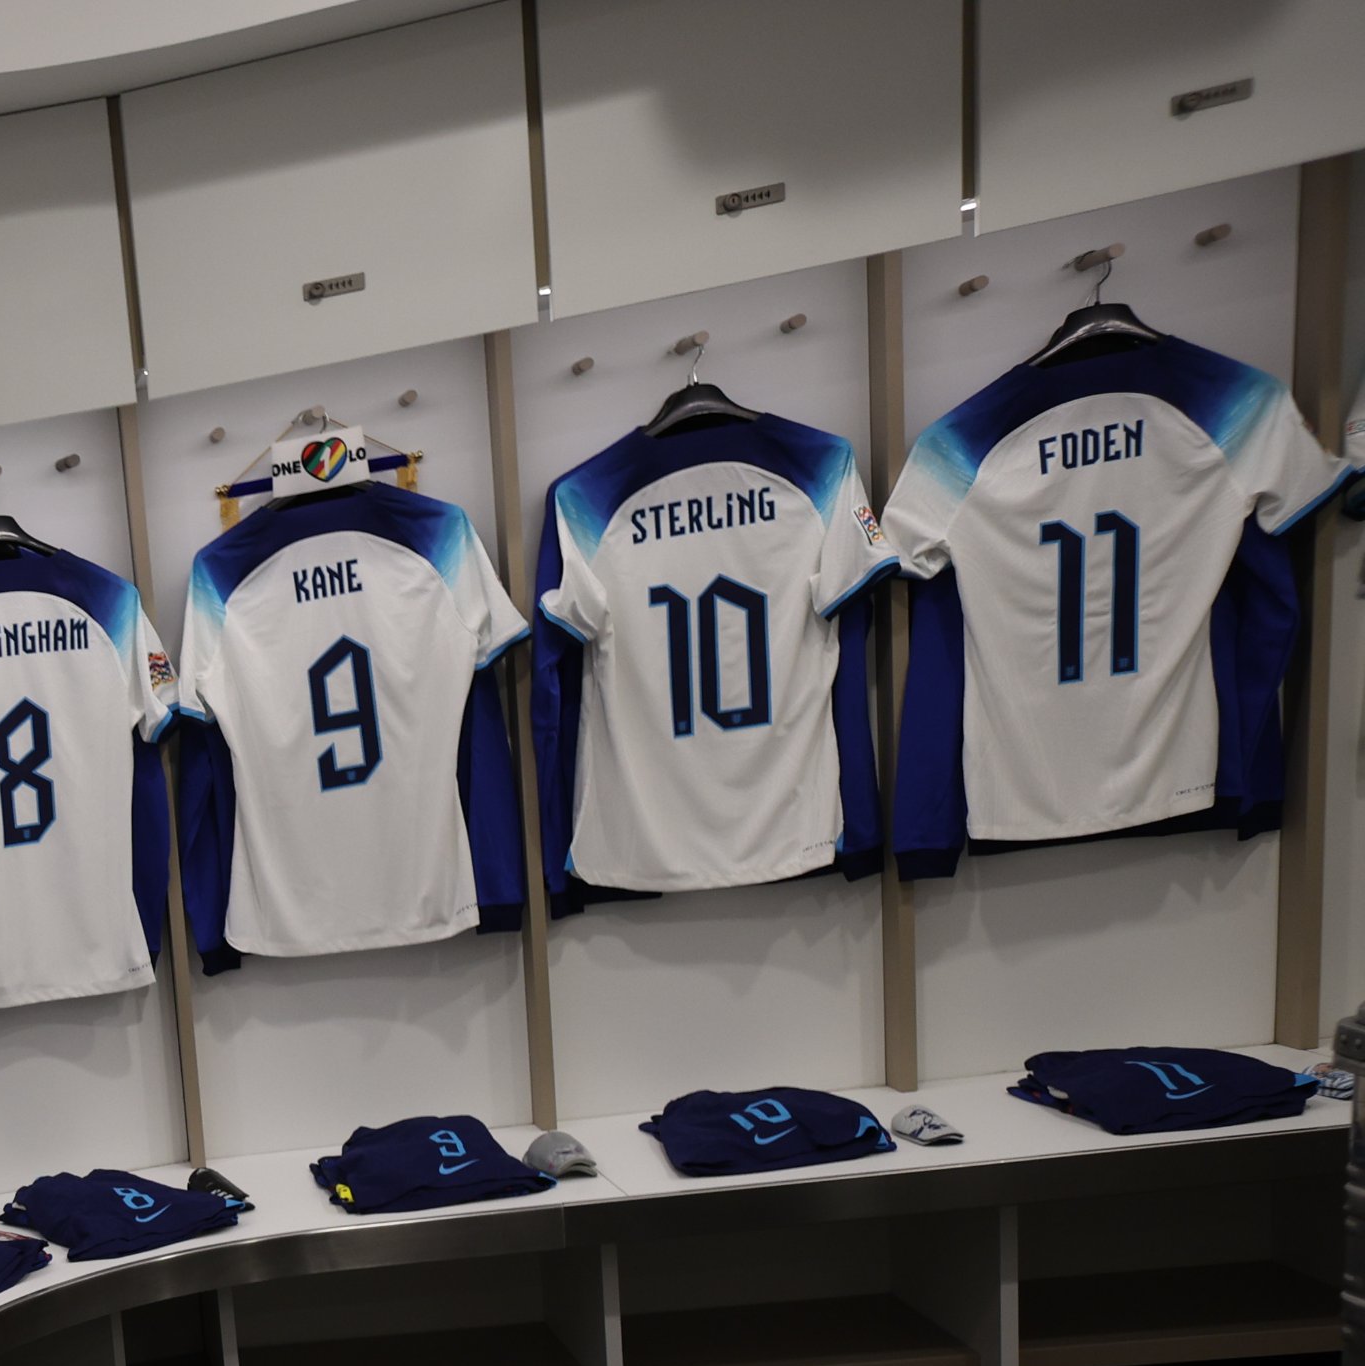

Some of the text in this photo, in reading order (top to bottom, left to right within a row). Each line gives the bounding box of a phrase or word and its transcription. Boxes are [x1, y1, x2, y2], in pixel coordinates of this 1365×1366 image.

[272, 460, 301, 477] ONE
[349, 447, 366, 462] LO
[1039, 419, 1144, 475] FODEN
[293, 559, 363, 603] KANE
[1039, 509, 1141, 685] 11
[648, 573, 772, 739] 10
[307, 634, 383, 793] 9
[1124, 1061, 1205, 1090] 11
[730, 1098, 792, 1131] 10
[429, 1129, 466, 1158] 9
[113, 1187, 155, 1210] 8
